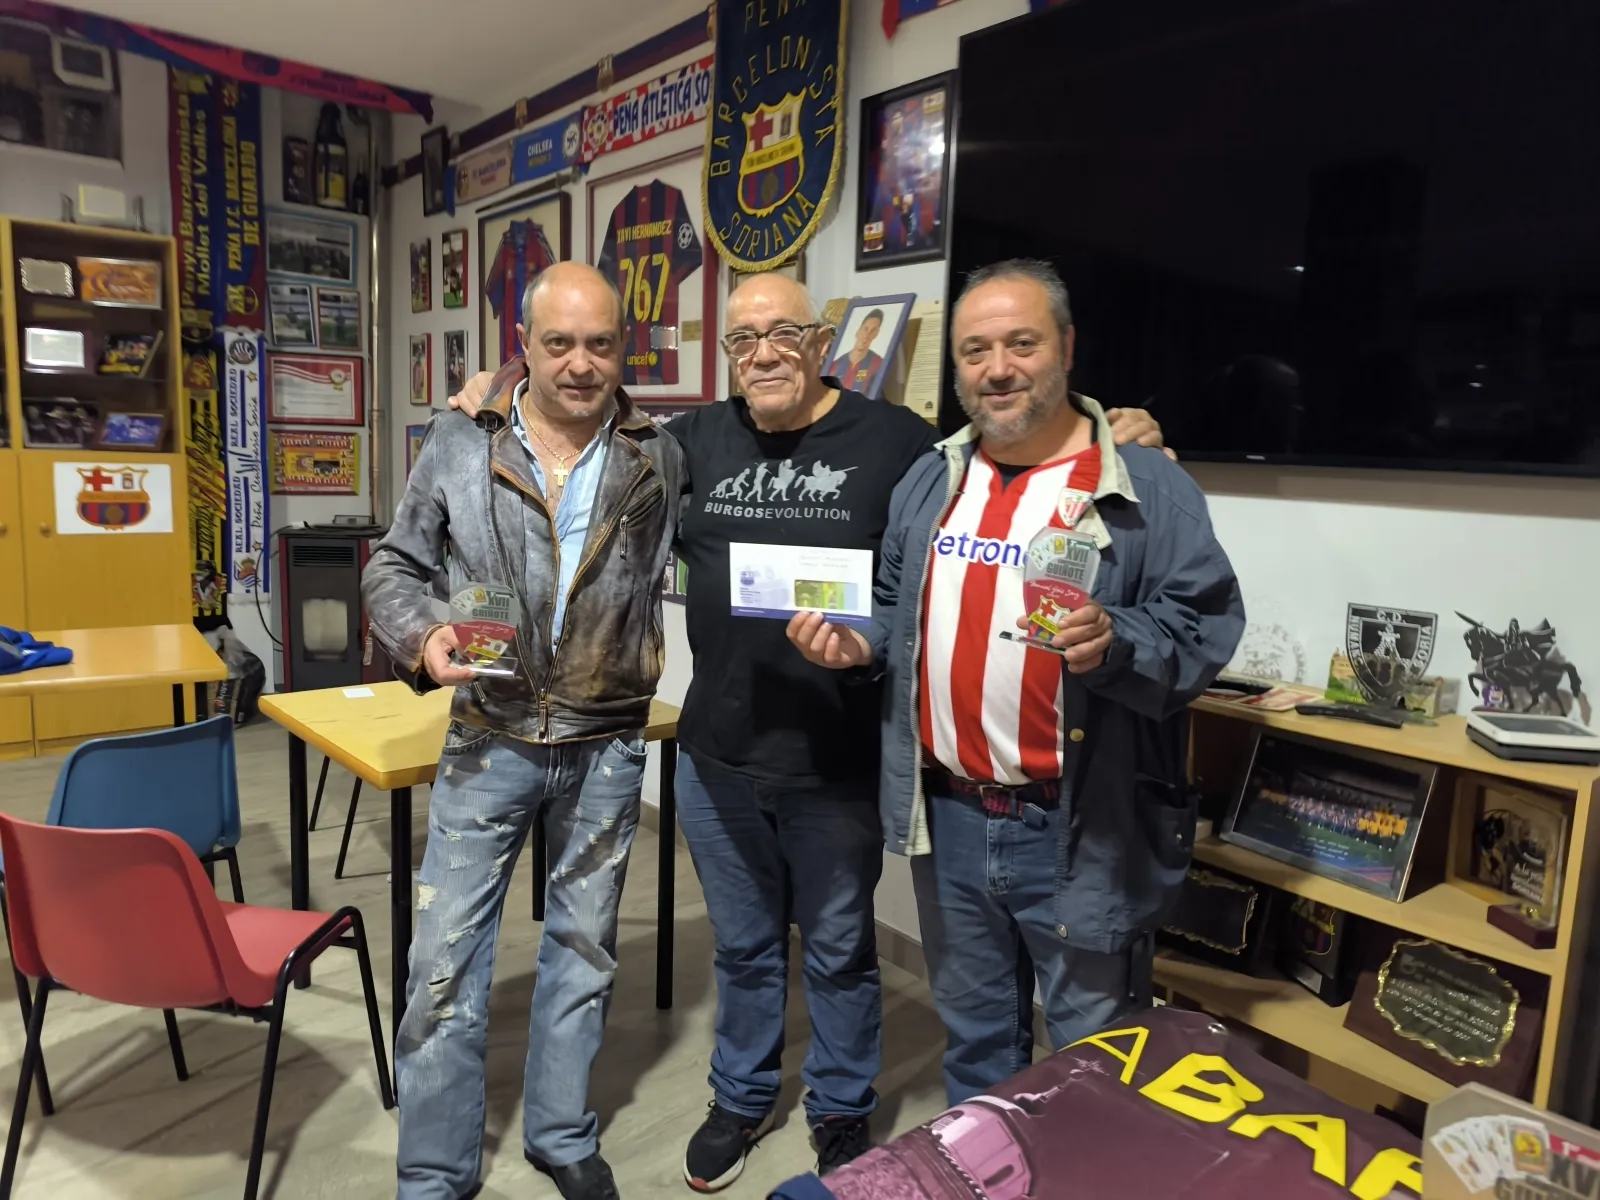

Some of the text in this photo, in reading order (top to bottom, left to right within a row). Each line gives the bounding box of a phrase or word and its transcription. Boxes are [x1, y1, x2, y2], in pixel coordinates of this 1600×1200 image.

[710, 35, 840, 177] BARCELONISTA
[527, 138, 553, 156] CHELSEA
[194, 182, 208, 218] del
[240, 141, 259, 245] DE GUARDO
[616, 219, 673, 244] XAVI HERNANDEZ
[719, 192, 815, 258] SORIANA
[181, 241, 196, 307] Penya
[195, 225, 211, 295] Mollet
[619, 252, 671, 323] 767
[626, 352, 649, 366] unicef
[228, 368, 243, 553] REAL SOCIEDAD REAL SOCIEDAD
[703, 501, 852, 521] BURGOSEVOLUTION
[933, 530, 1029, 567] etron
[1066, 546, 1089, 564] XVII
[1046, 562, 1085, 581] GUIÑOTE
